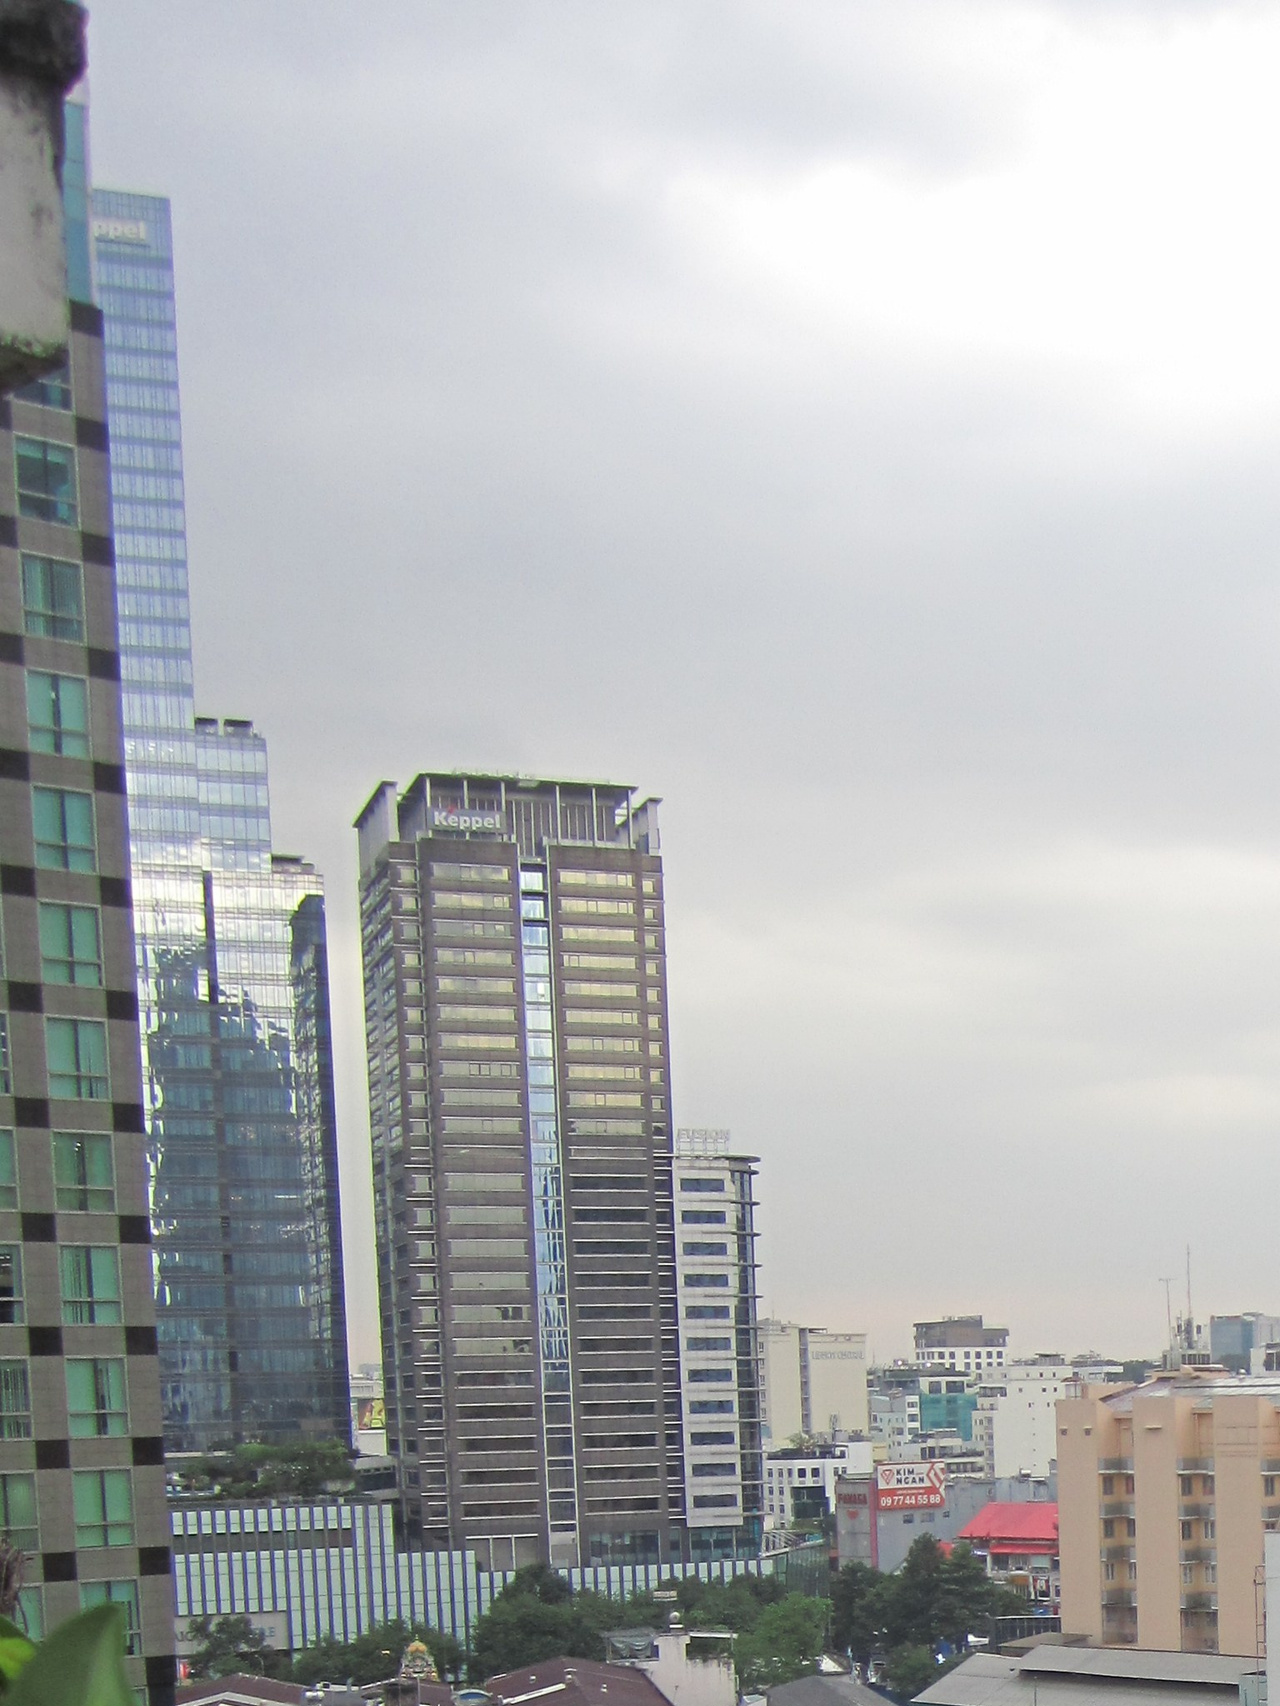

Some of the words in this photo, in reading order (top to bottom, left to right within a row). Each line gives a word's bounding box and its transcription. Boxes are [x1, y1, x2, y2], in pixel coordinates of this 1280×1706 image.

[93, 220, 146, 240] ppel
[433, 811, 501, 830] Keppel
[896, 1468, 915, 1476] KIM
